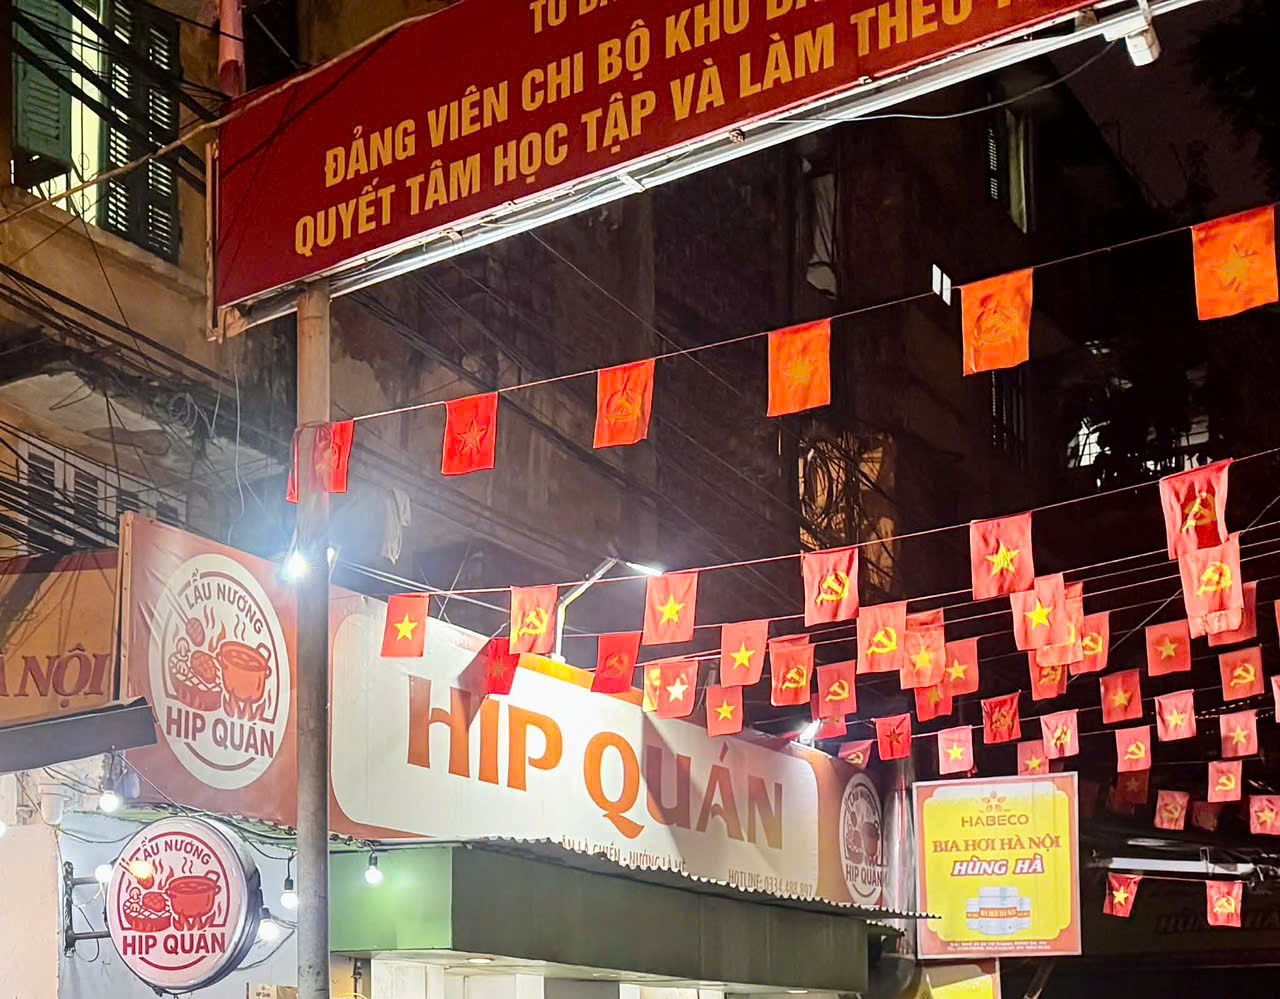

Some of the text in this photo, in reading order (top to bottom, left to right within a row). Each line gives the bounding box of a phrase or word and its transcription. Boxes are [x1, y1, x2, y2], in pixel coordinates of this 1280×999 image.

[325, 0, 750, 188] ĐẢNG VIÊN CHI BỘ KHU
[295, 0, 972, 257] QUYẾT TÂM HỌC TẬP VÀ LÀM THEO
[216, 582, 264, 636] NƯỚNG
[20, 642, 111, 709] NỘI
[166, 705, 275, 758] HIP QUÁN
[407, 674, 783, 850] HIP QUÁN
[932, 832, 1061, 853] BIA HƠI HÀ NỘI
[961, 814, 1029, 828] HABECO
[136, 836, 212, 866] ẨU NƯỚNG
[951, 853, 1044, 876] HÙNG HÀ
[122, 929, 226, 957] HIP QUÁN
